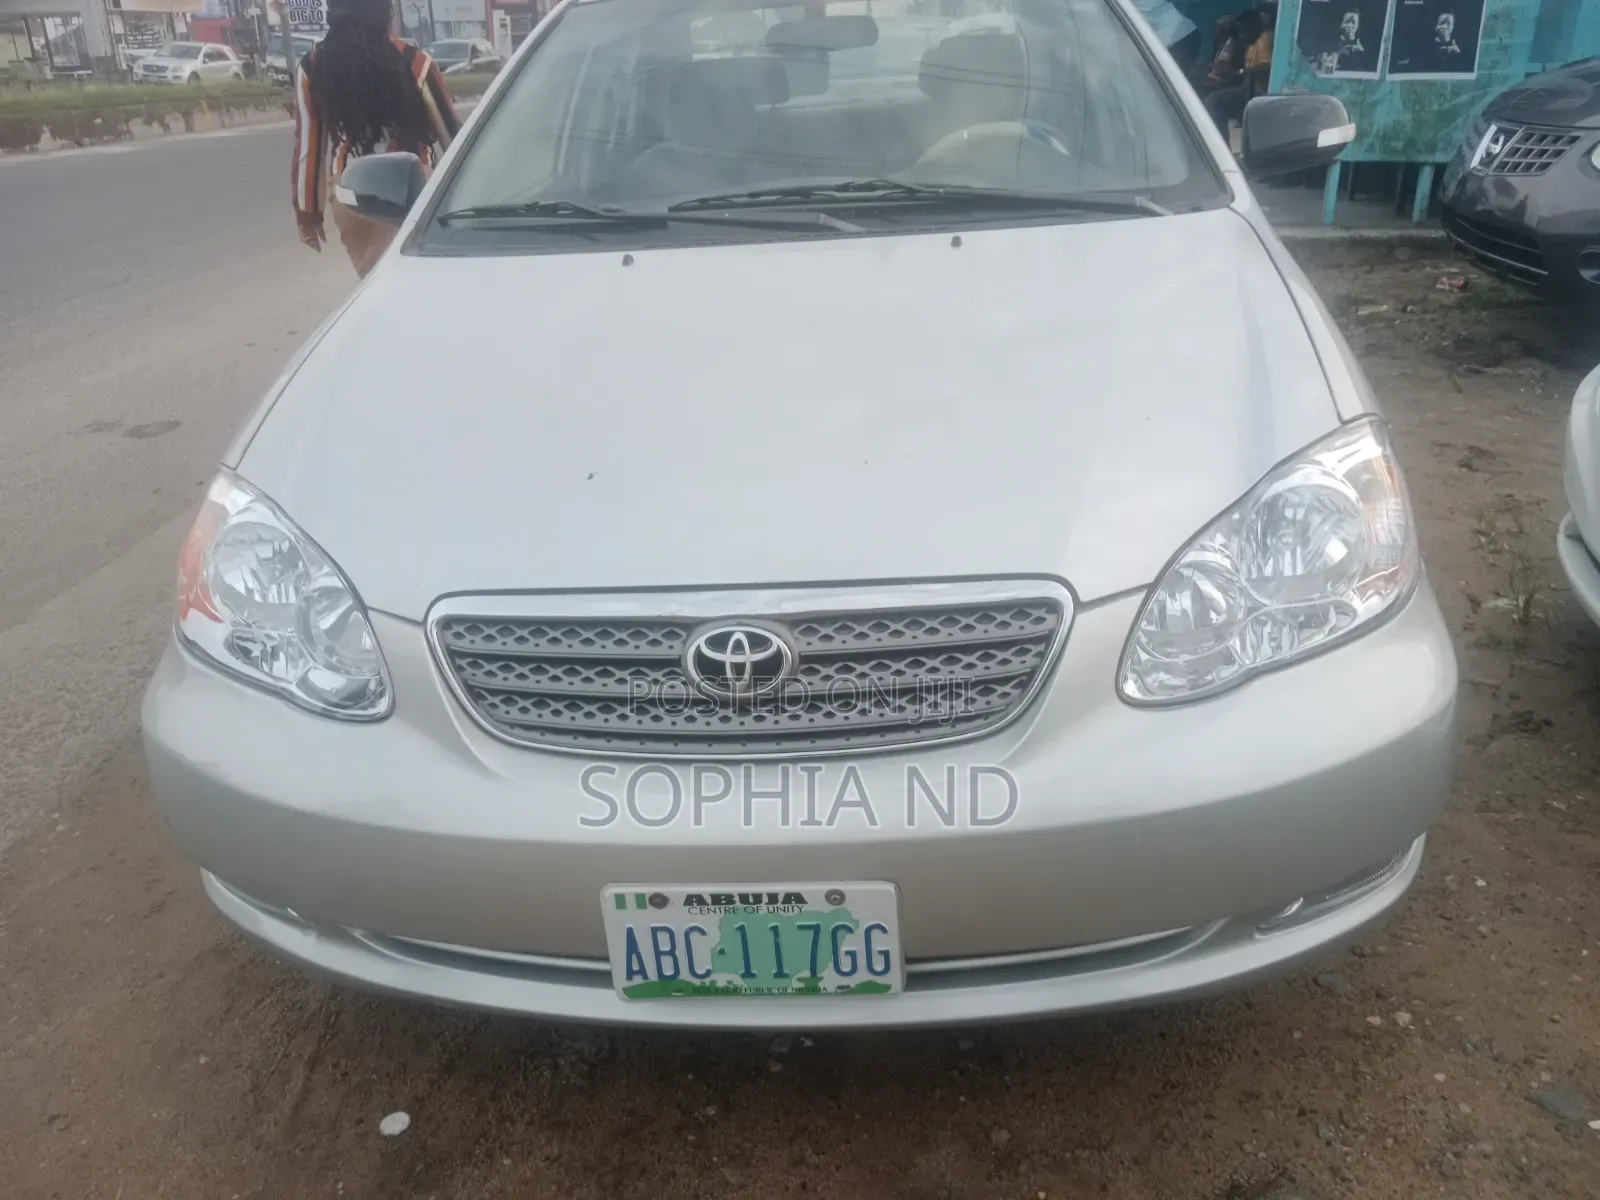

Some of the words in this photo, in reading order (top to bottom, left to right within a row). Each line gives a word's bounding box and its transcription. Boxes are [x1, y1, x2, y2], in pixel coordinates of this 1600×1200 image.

[290, 10, 308, 21] BIG
[310, 10, 323, 21] TO
[683, 892, 809, 906] ABUJA
[688, 906, 739, 916] CENTRE
[744, 906, 763, 915] OF
[767, 905, 805, 914] UNITY
